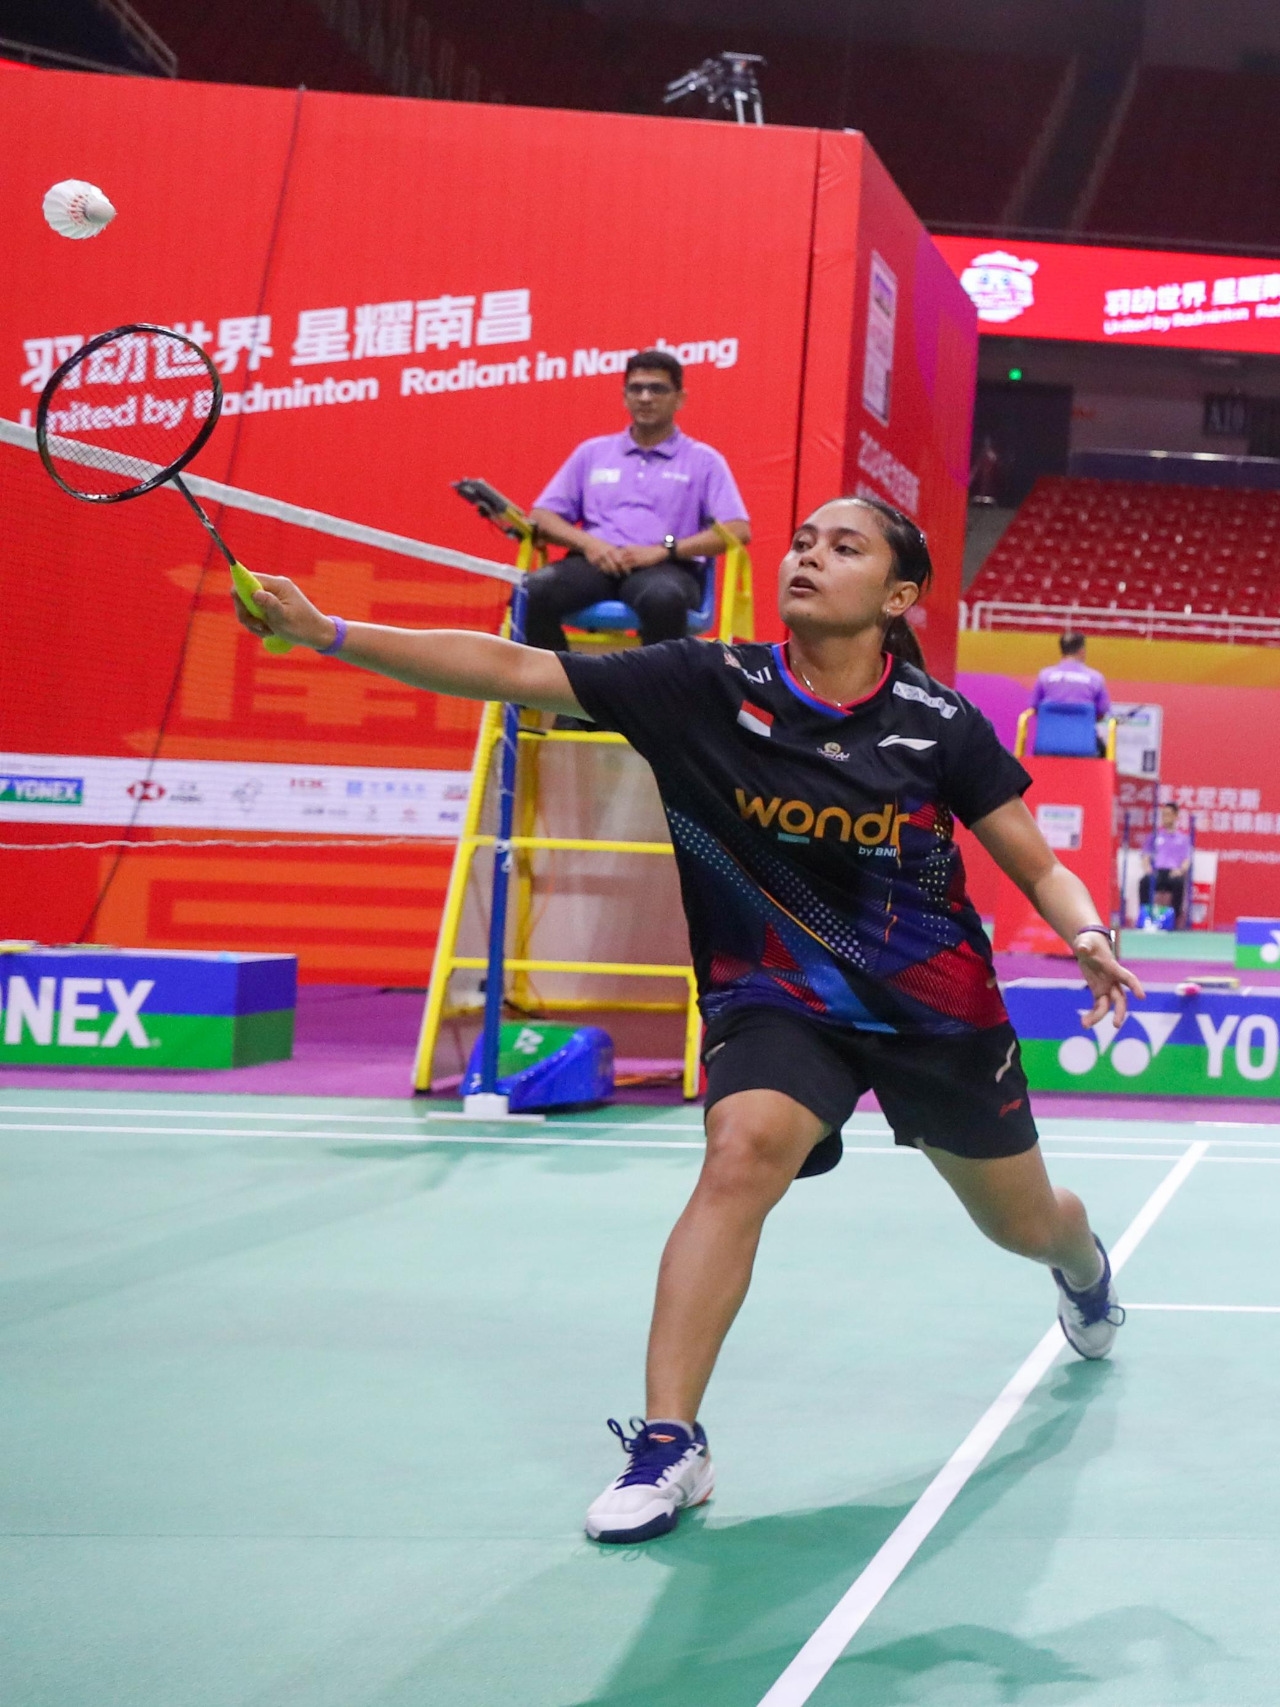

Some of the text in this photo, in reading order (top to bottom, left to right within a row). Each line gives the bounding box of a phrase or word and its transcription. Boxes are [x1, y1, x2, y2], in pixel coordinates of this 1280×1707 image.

[291, 288, 532, 367] 星耀南昌
[142, 393, 188, 429] by
[401, 356, 531, 396] Radiant
[536, 351, 567, 381] in
[735, 788, 910, 846] wondr
[858, 846, 897, 857] by BNI
[0, 975, 156, 1049] NEX
